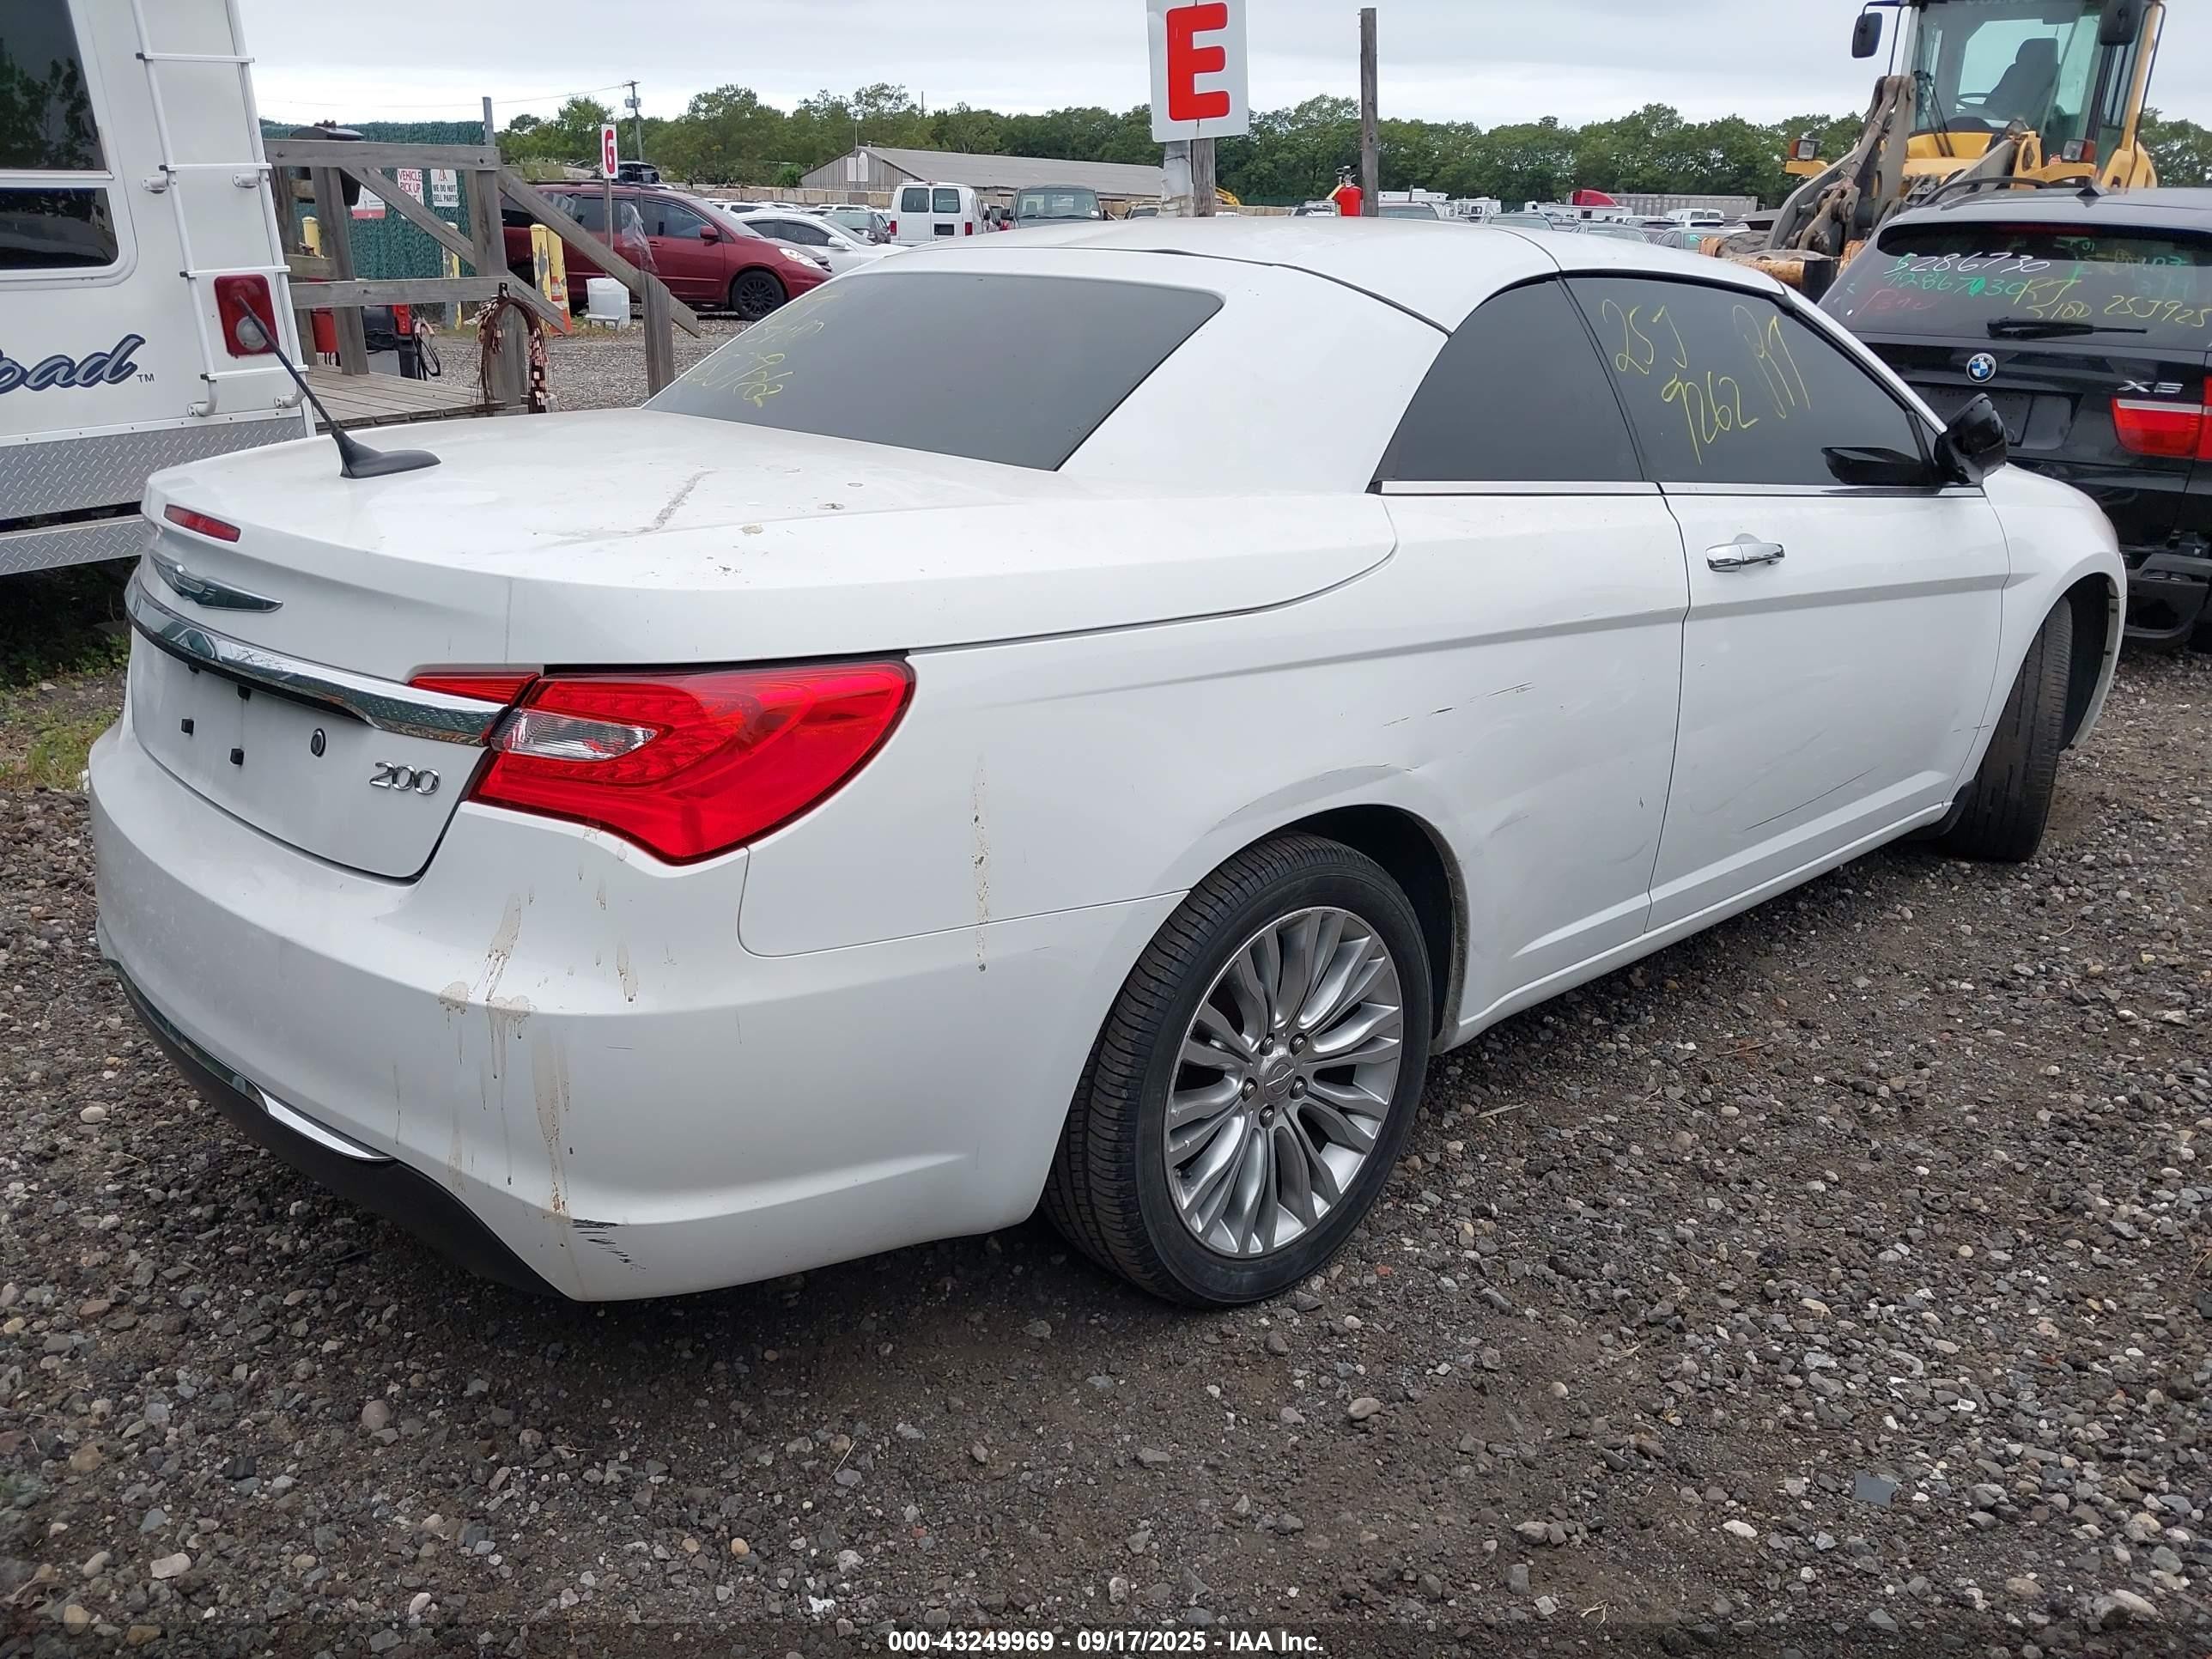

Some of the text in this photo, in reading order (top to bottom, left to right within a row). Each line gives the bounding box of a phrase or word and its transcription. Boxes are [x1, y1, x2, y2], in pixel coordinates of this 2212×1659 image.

[1166, 2, 1230, 121] E
[605, 129, 616, 174] G
[398, 170, 422, 182] VEHICLE
[413, 183, 421, 194] UP
[432, 184, 456, 193] WE DO NOT
[433, 194, 442, 203] SELL
[443, 194, 458, 203] PARTS
[2116, 380, 2185, 394] X5
[369, 761, 441, 795] 200
